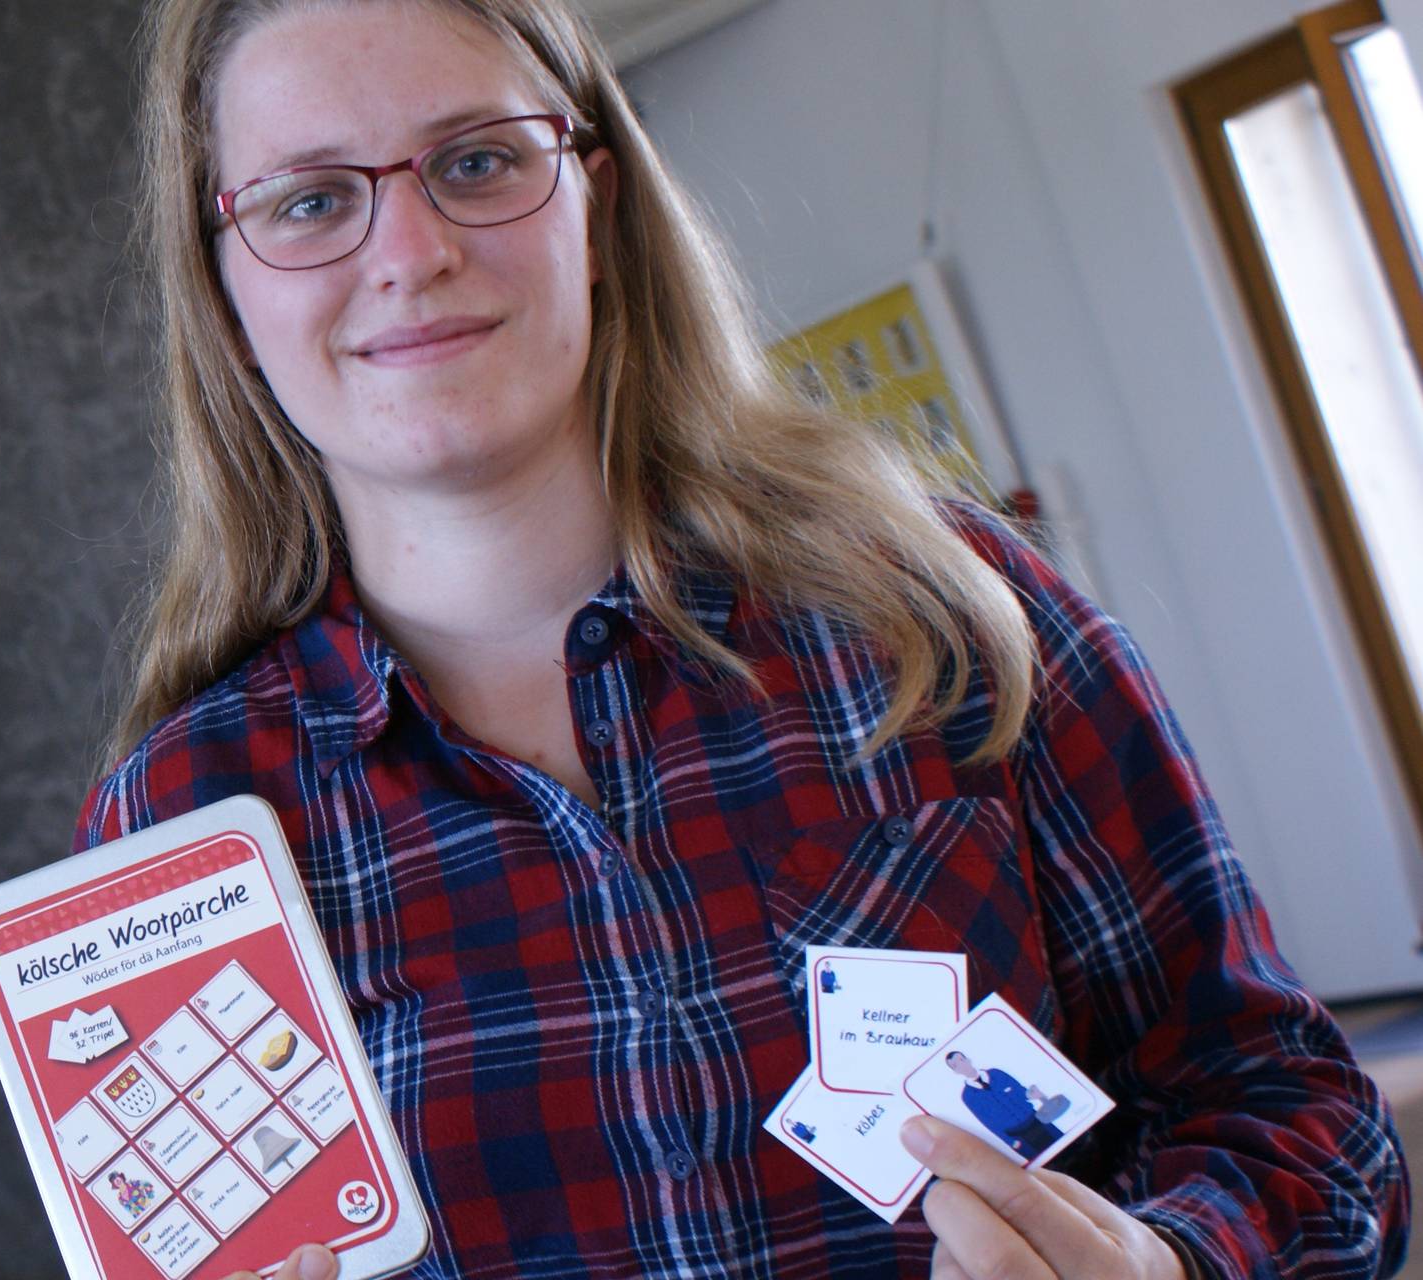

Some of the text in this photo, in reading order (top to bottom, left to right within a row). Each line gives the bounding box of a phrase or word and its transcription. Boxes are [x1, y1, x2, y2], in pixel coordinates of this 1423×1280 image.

[17, 884, 250, 987] kölsche Wootpärche
[81, 933, 203, 986] Wöder för dä Aanfang
[861, 1008, 911, 1025] Kellner
[839, 1030, 937, 1048] im Brauhaus
